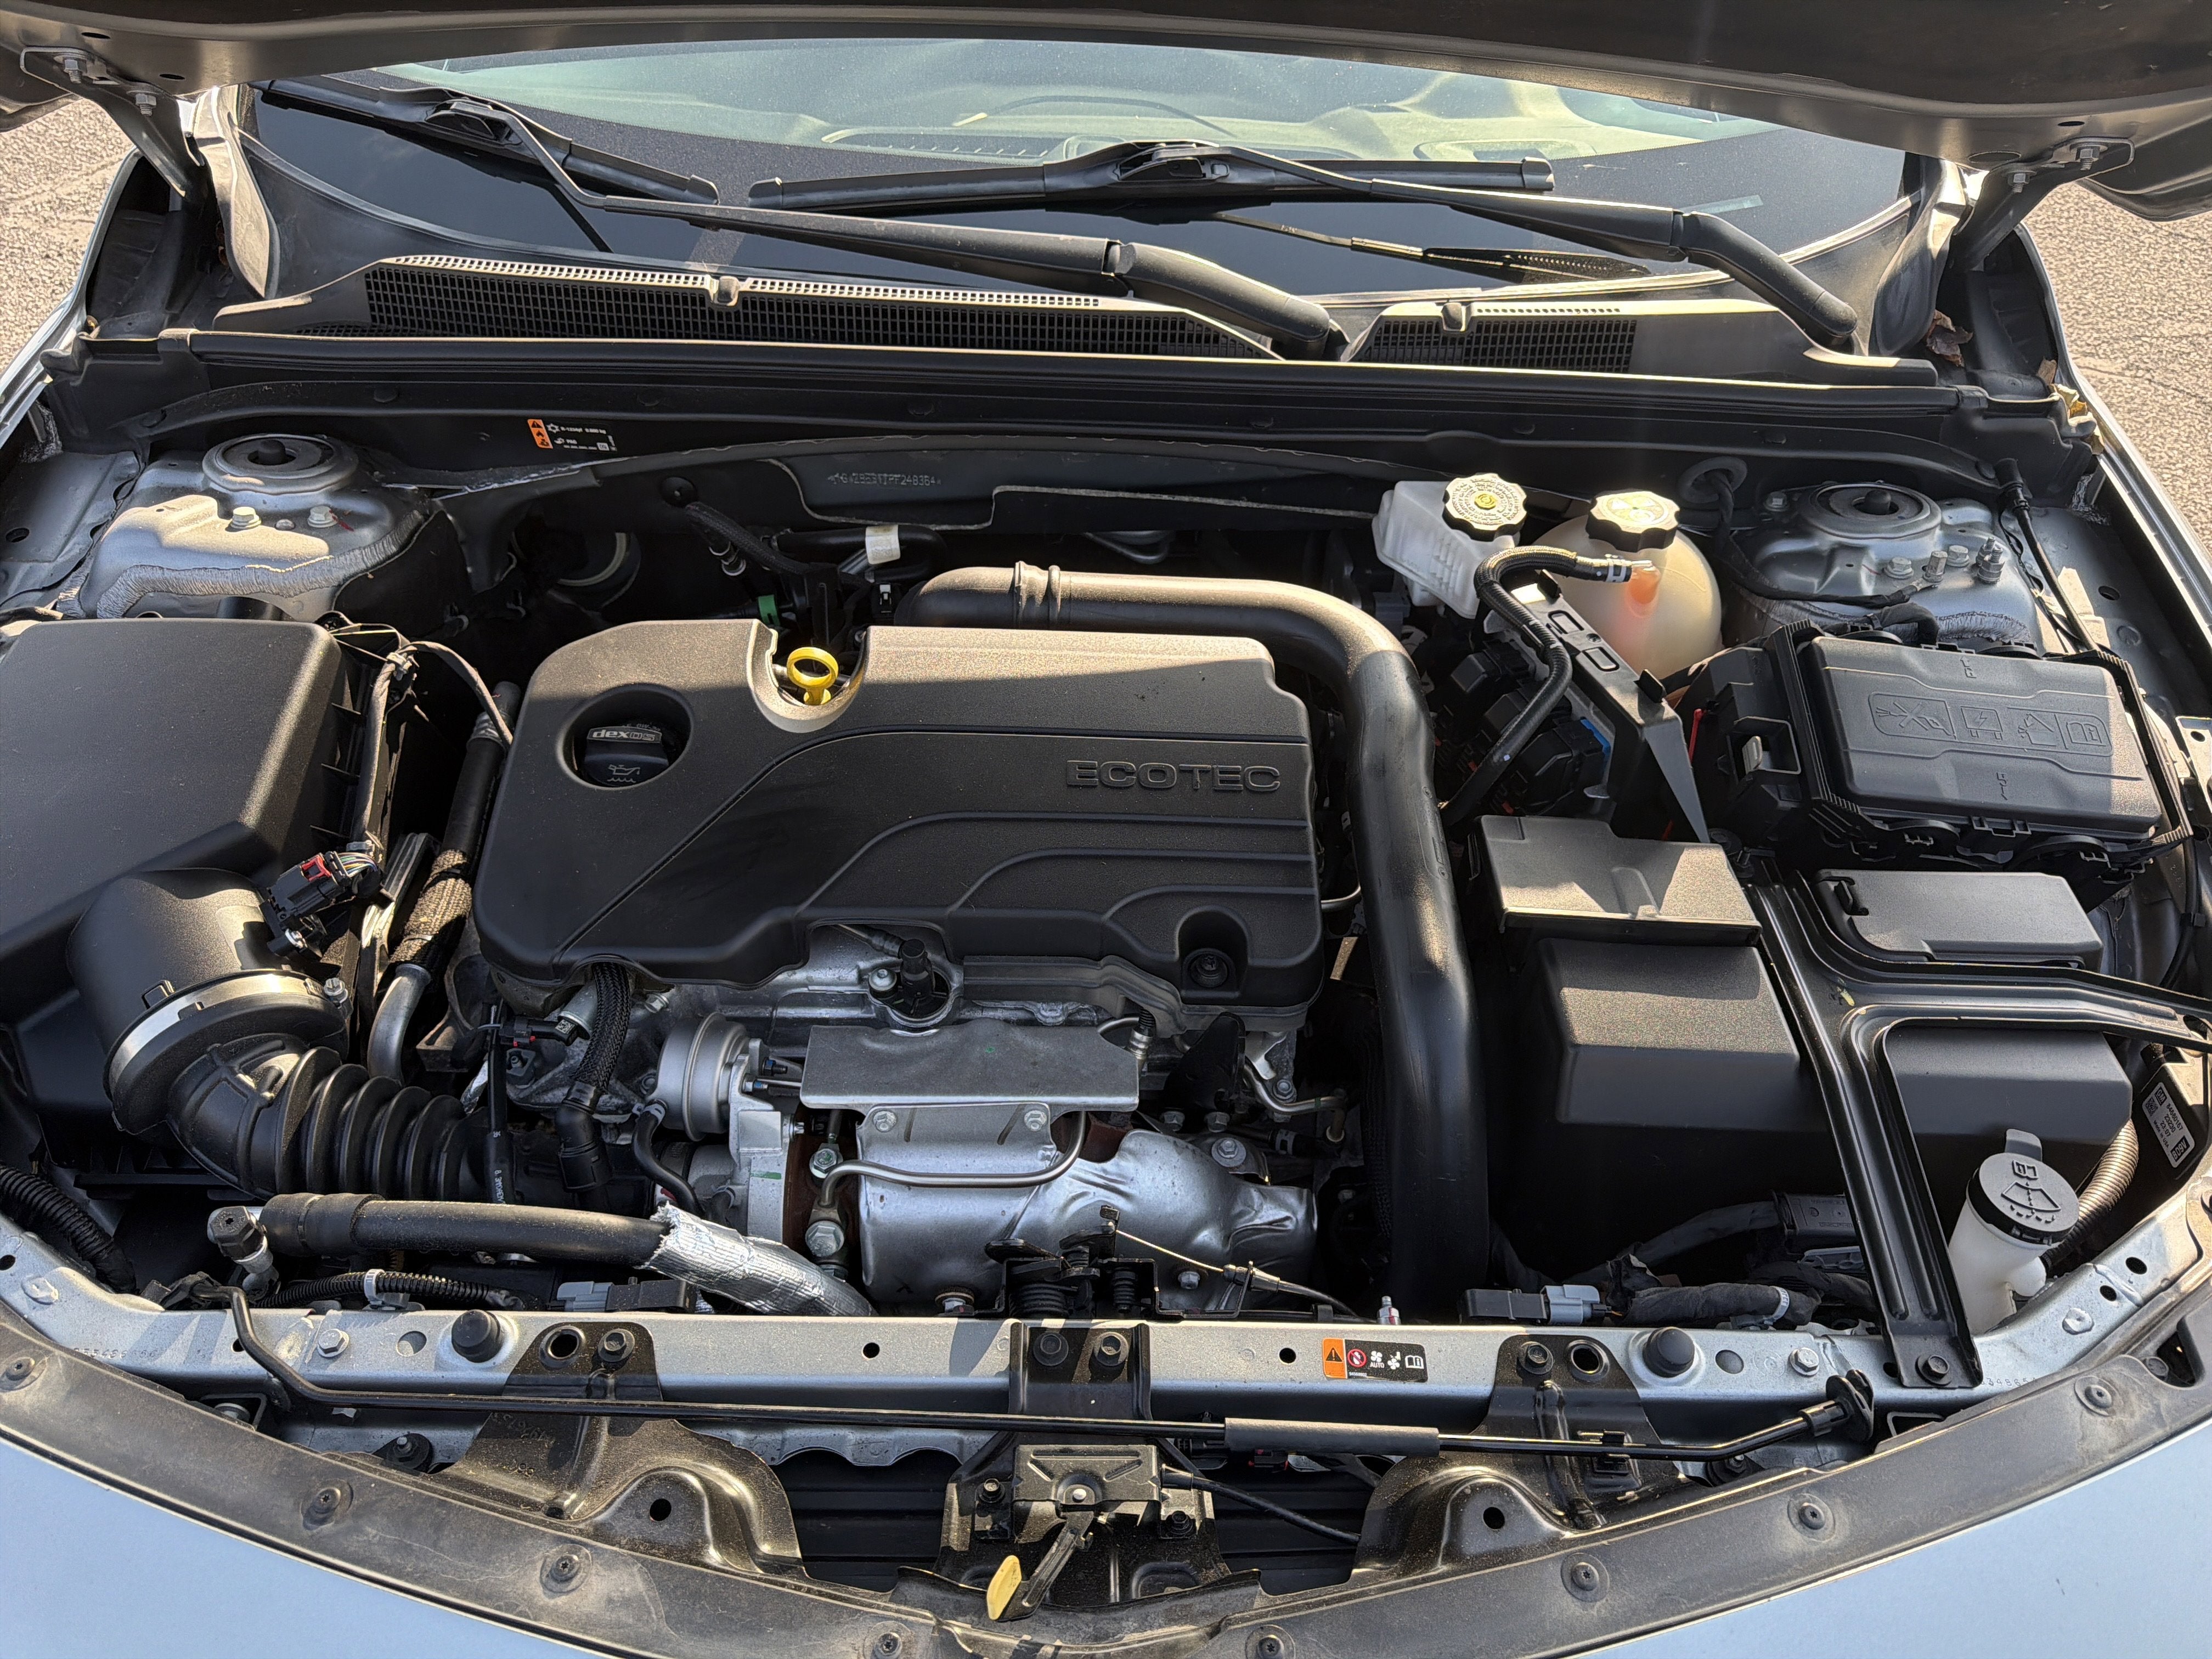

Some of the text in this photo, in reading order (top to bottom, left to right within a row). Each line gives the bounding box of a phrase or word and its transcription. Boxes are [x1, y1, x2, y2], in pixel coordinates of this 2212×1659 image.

[592, 729, 656, 741] dexos
[1066, 760, 1281, 792] ECOTEC
[2155, 1088, 2166, 1104] GM
[2164, 1114, 2176, 1133] 23230
